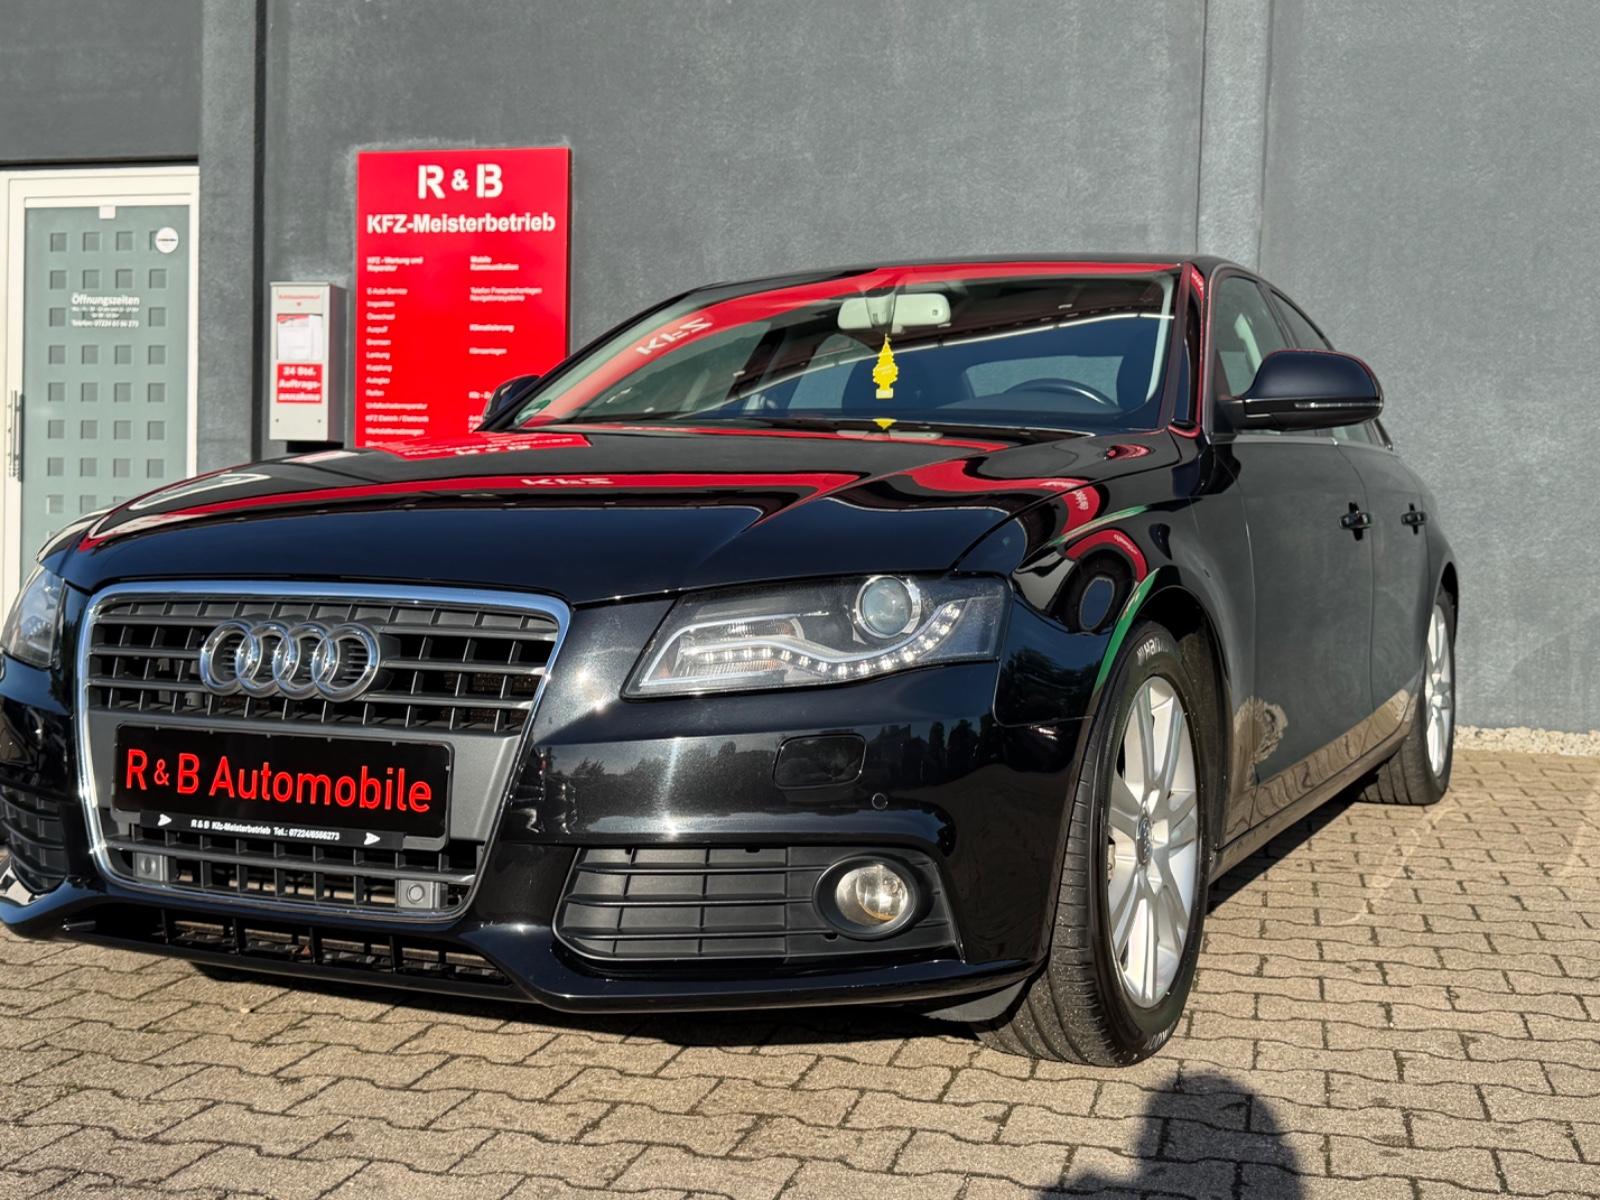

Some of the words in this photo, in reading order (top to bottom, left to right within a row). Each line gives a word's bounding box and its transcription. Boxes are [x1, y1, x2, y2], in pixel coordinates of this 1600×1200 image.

[417, 164, 446, 200] R
[451, 168, 470, 191] &
[476, 163, 504, 198] B
[366, 211, 556, 234] KFZ-Meisterbetrieb
[72, 292, 140, 307] Öffnungszeiten
[126, 749, 147, 790] R
[154, 758, 169, 786] &
[177, 753, 200, 793] B
[209, 755, 432, 813] Automobile
